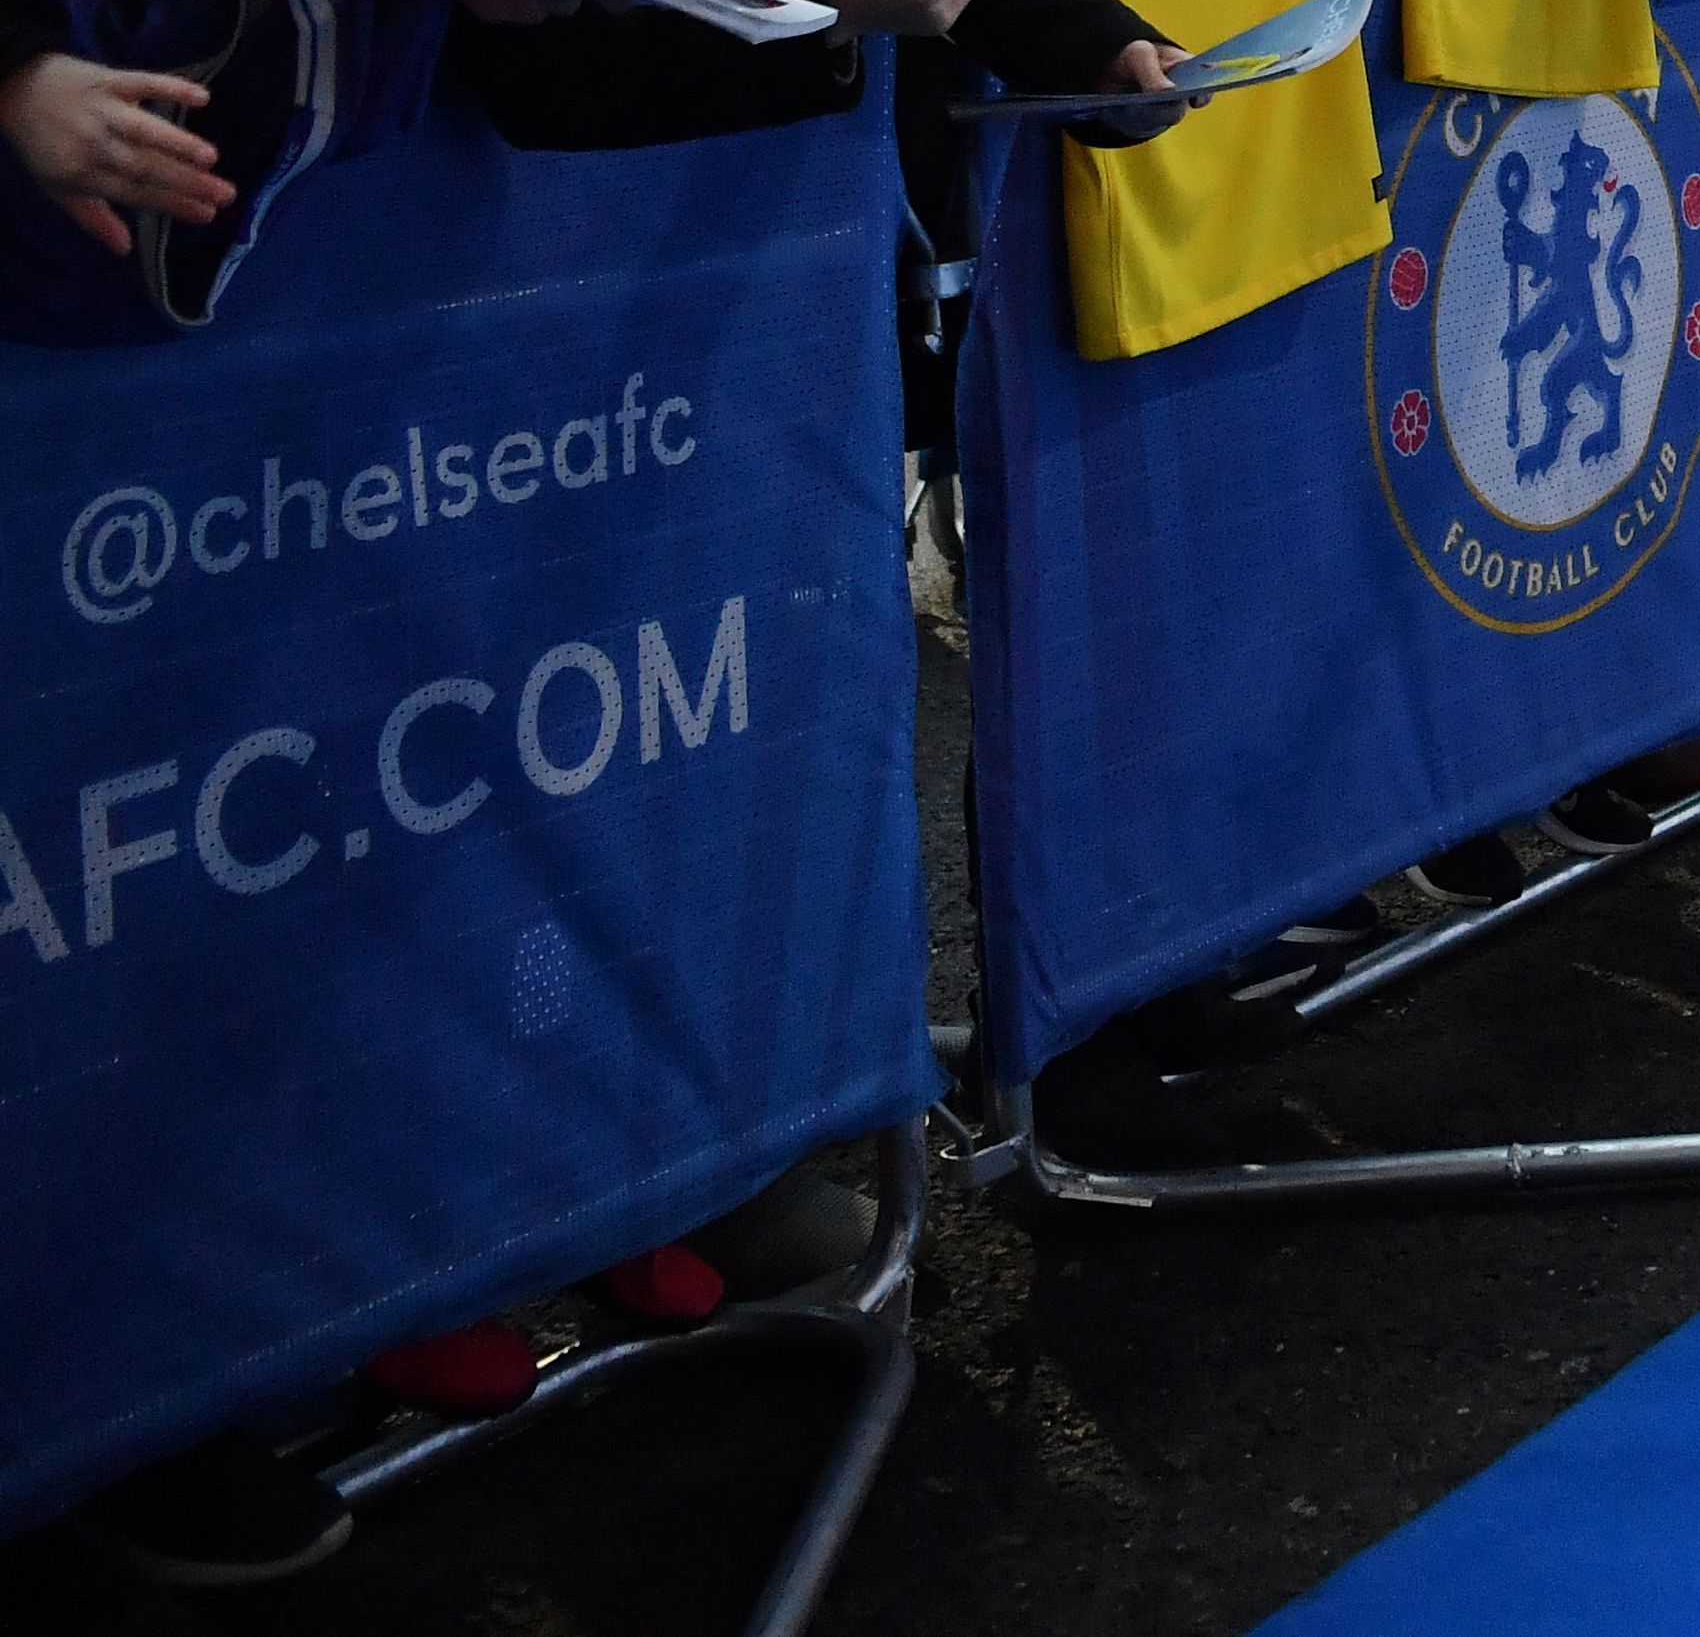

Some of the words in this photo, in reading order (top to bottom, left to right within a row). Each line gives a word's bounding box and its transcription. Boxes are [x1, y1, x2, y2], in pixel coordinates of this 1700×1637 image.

[60, 370, 699, 626] @chelseafc
[1443, 518, 1600, 600] FOOTBALL
[1613, 441, 1679, 548] CLUB
